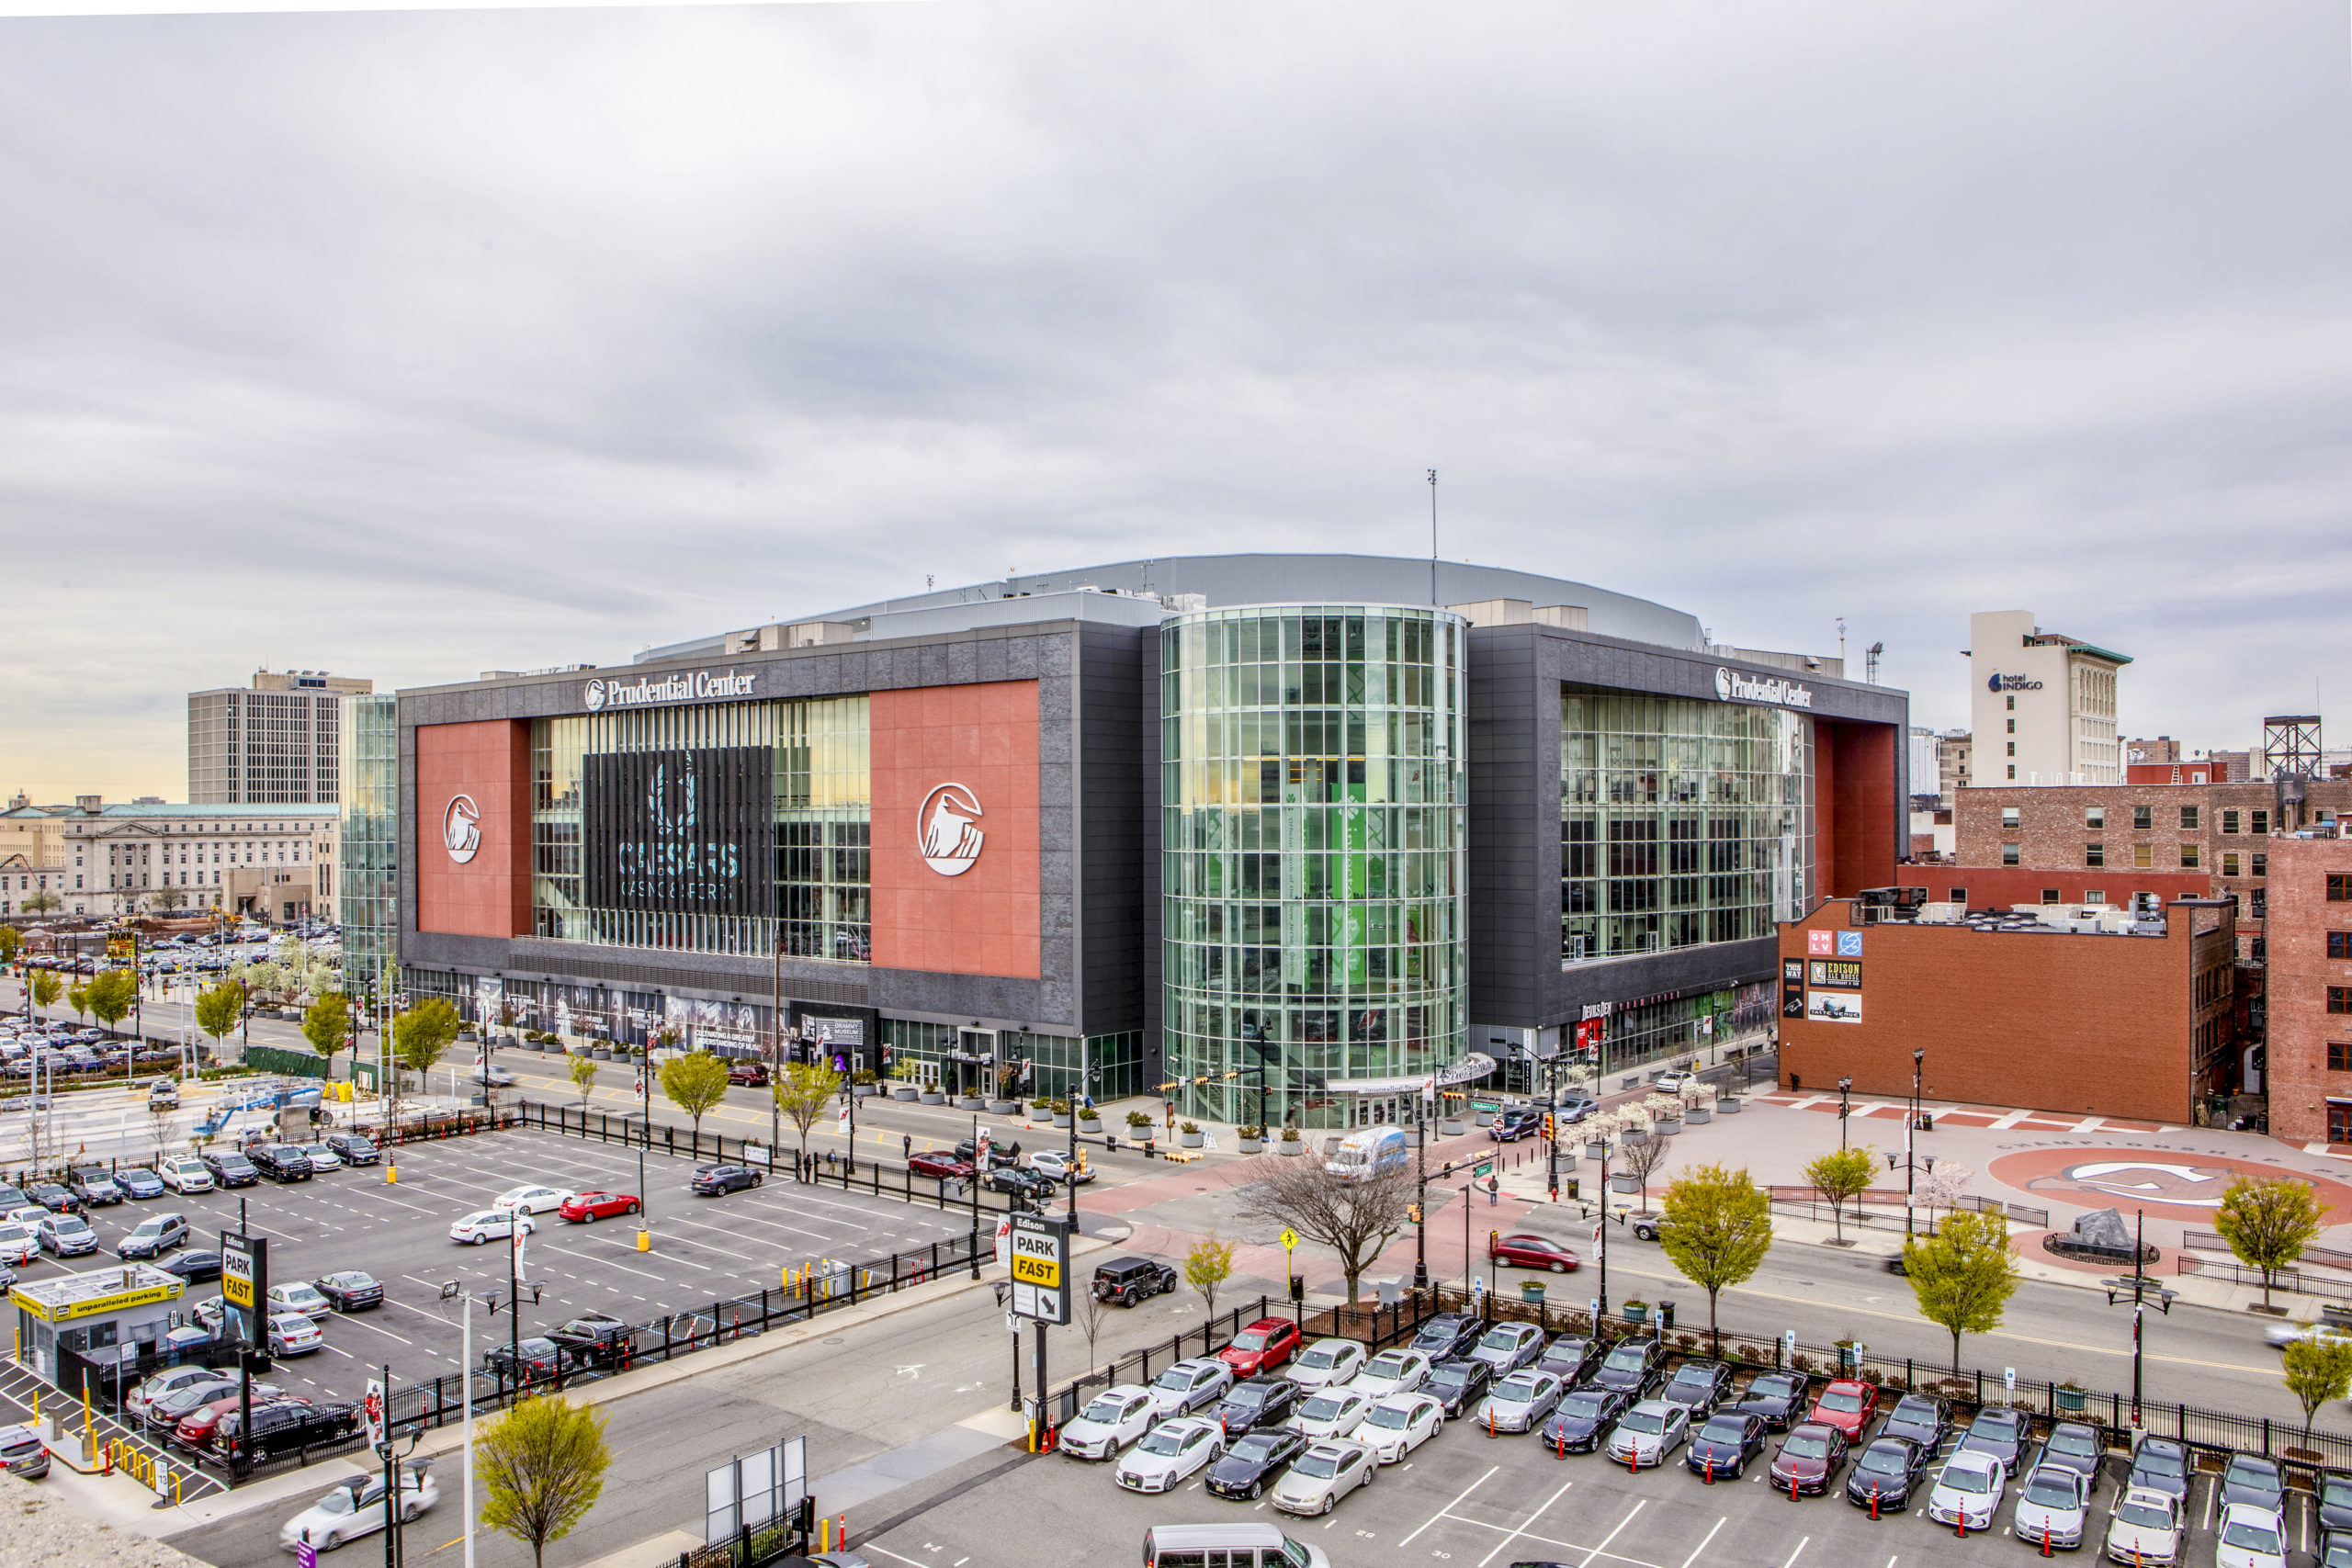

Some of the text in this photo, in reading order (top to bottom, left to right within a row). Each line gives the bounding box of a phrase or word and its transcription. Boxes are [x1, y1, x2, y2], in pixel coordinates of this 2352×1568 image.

[607, 669, 756, 706] Prudential Center
[1730, 671, 1812, 708] Prudential Center
[2003, 672, 2043, 691] hotel INDIGO
[108, 932, 133, 941] PARK
[1785, 970, 1802, 978] WAY
[1827, 963, 1860, 975] EDISON
[1582, 1001, 1612, 1021] DEVILS DEN
[695, 1030, 727, 1040] CULTIVATING
[731, 1034, 755, 1043] GREATER
[1996, 1140, 2280, 1163] CHAMPIONSHIP
[1016, 1217, 1045, 1232] Edison
[225, 1235, 244, 1249] Edison
[1017, 1236, 1055, 1257] PARK
[225, 1254, 250, 1276] PARK
[1018, 1259, 1054, 1280] FAST
[226, 1278, 250, 1300] FAST
[77, 1291, 162, 1313] unparalleled parking
[1355, 1529, 1375, 1539] 29
[1431, 1550, 1452, 1559] 30
